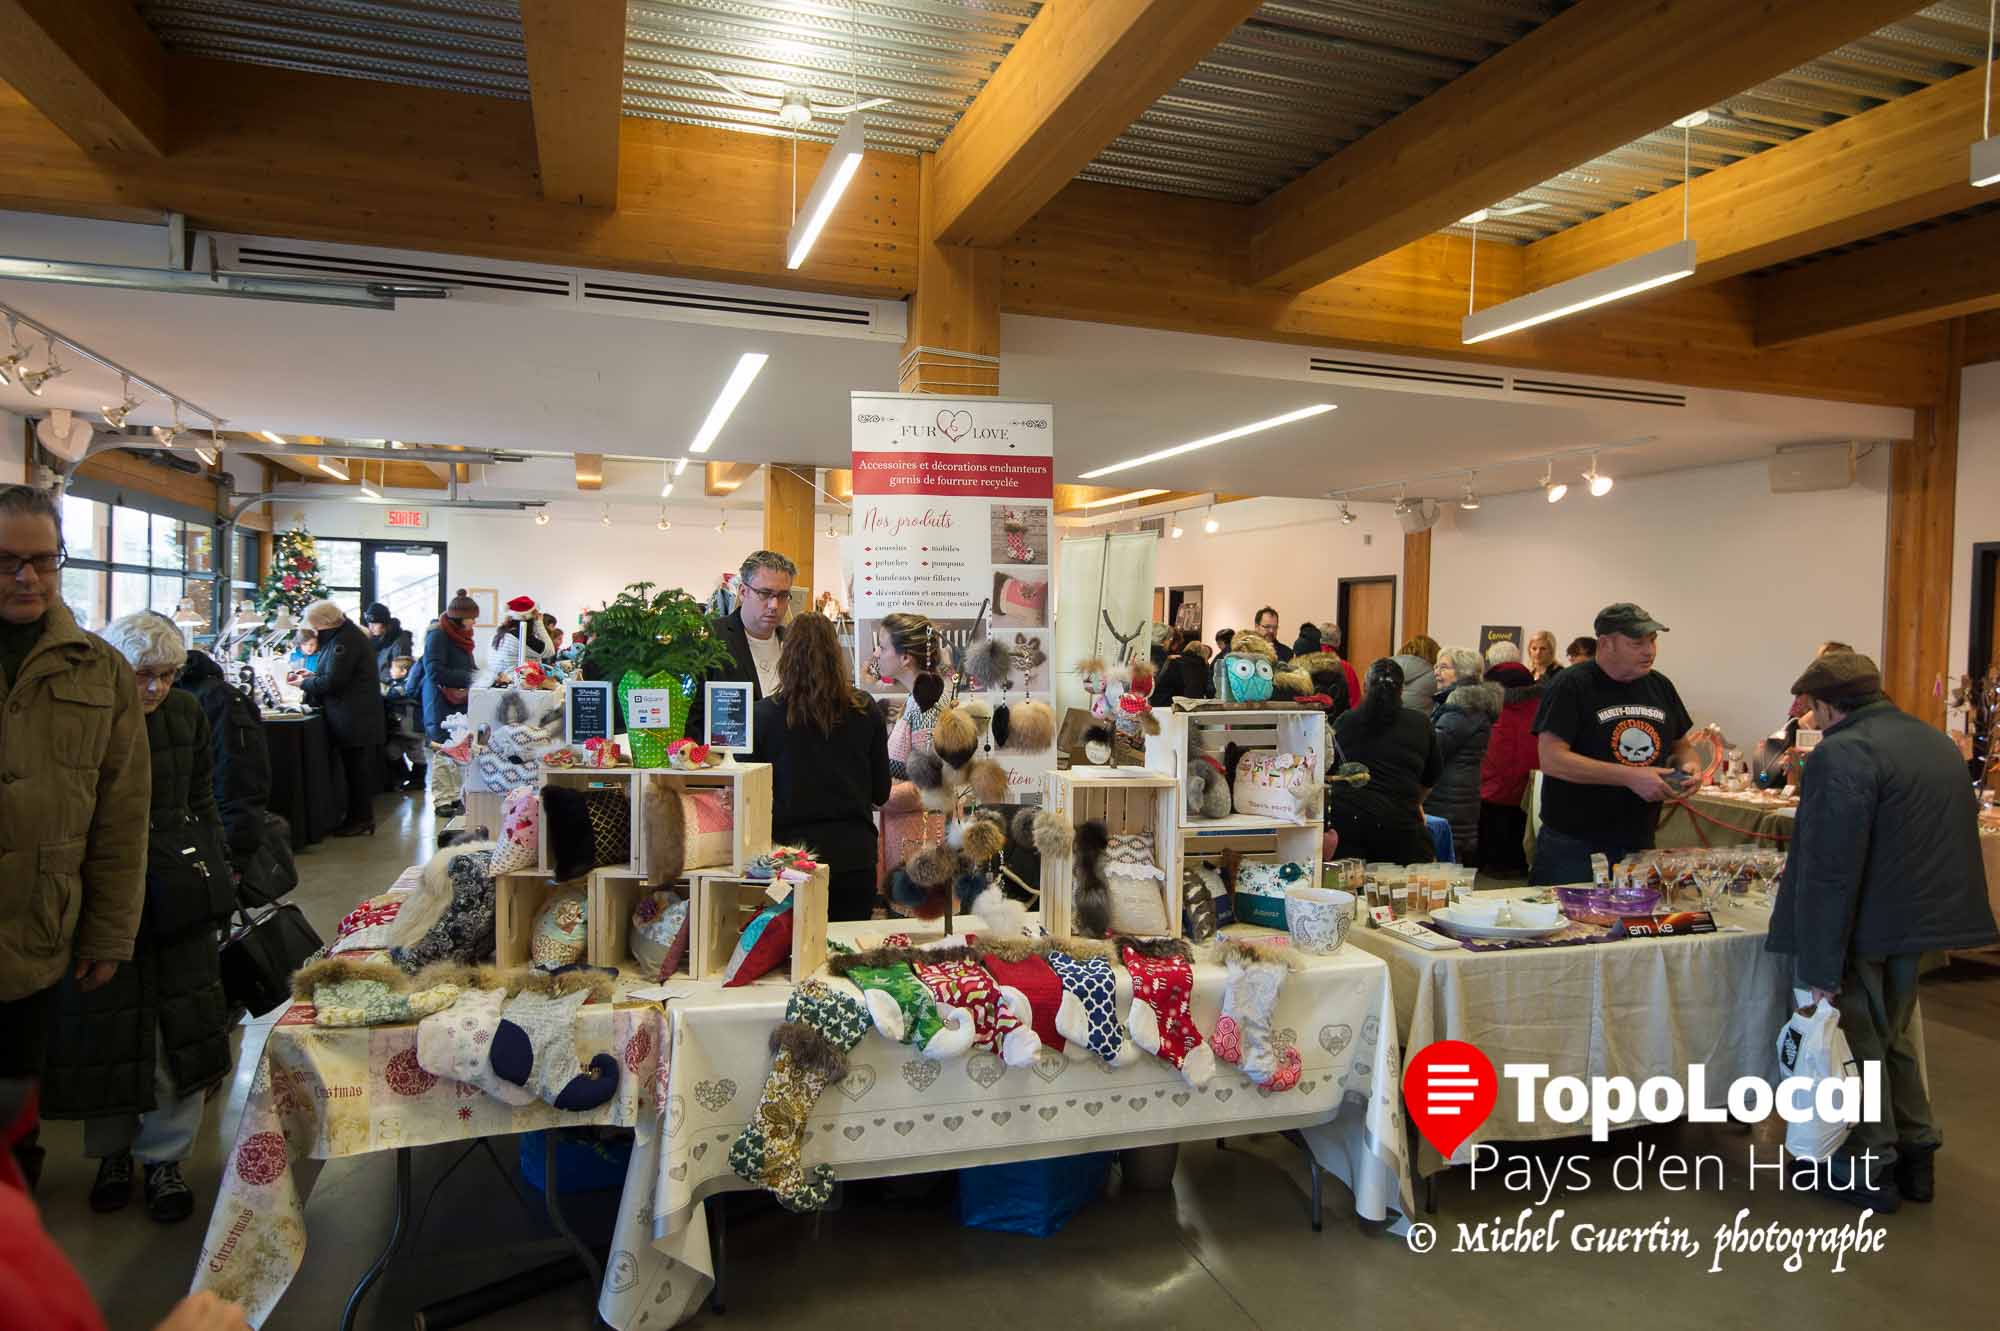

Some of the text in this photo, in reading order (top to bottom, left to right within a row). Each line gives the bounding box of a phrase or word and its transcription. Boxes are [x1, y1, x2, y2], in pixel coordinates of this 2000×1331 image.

[901, 425, 936, 437] FUR
[972, 428, 1009, 440] LOVE
[858, 460, 1048, 475] Accessoires et décorations enchanteurs
[889, 475, 1020, 490] garnis de fourrure recyclée
[388, 511, 422, 526] SORTIE
[863, 506, 953, 536] Nos produits
[931, 544, 961, 553] mobiles
[874, 559, 965, 569] peluches pompons
[875, 573, 961, 584] bandeaux pour fillettes
[875, 588, 969, 598] décorations et ornements
[887, 599, 899, 609] gré
[901, 599, 915, 607] des
[916, 599, 934, 608] fêtes
[935, 600, 944, 608] et
[945, 599, 958, 608] des
[959, 600, 983, 608] saison
[1598, 706, 1664, 721] HARLEY-DAVIDSON
[1629, 917, 1674, 936] smke
[209, 1207, 254, 1273] Christmas
